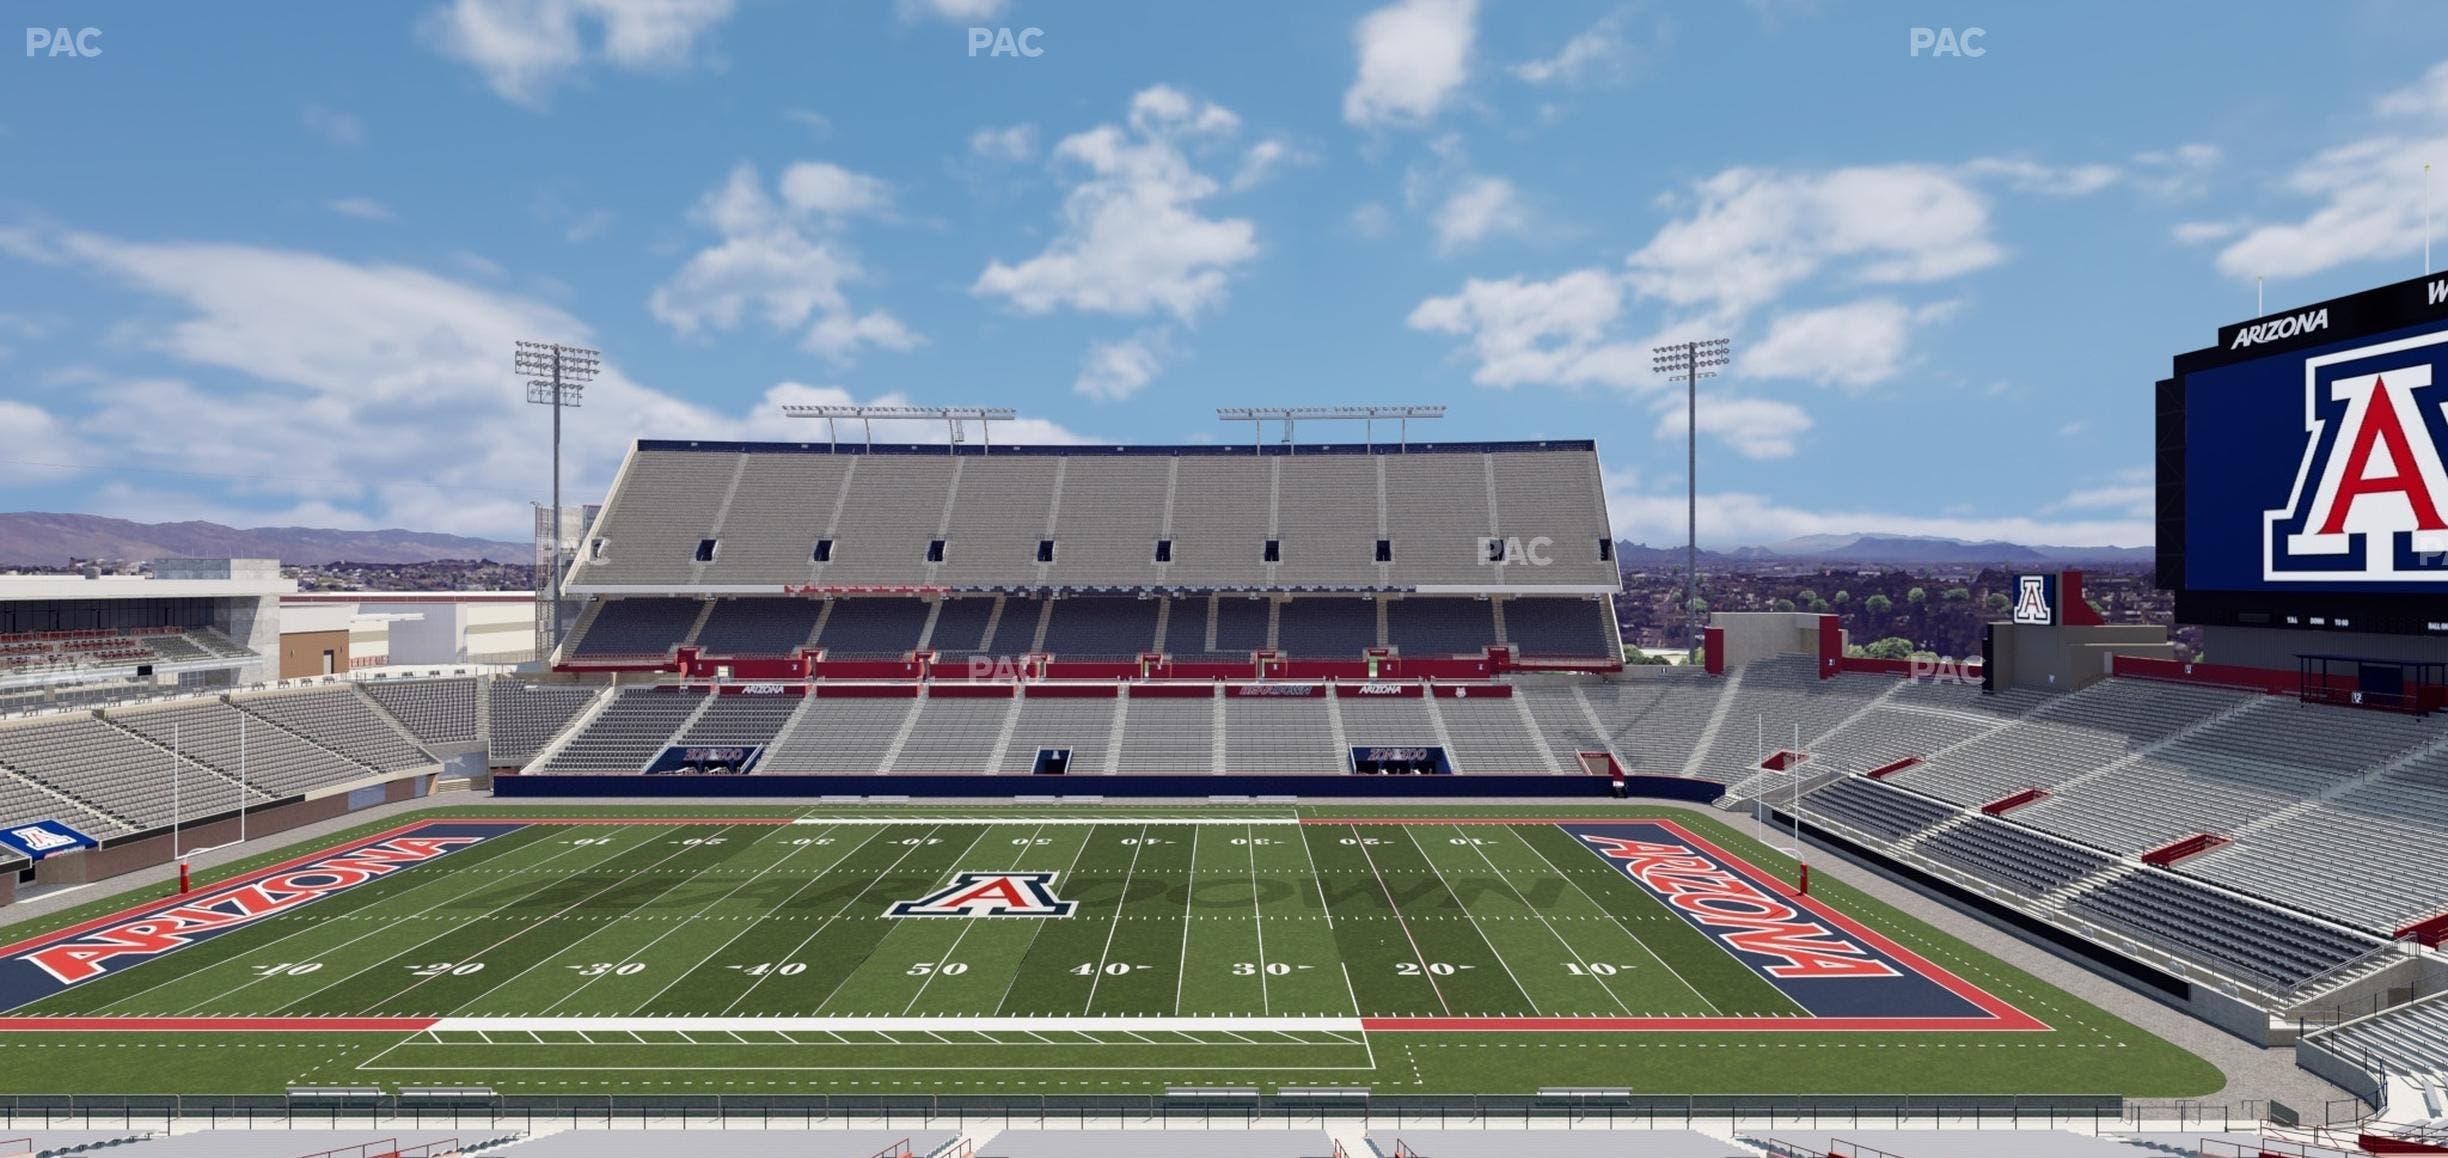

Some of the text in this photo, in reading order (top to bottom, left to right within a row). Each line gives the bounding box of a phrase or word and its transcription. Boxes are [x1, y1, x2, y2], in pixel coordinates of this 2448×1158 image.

[2231, 308, 2329, 350] ARIZONA
[2014, 575, 2051, 625] A
[741, 684, 784, 695] ARIZONA
[1359, 684, 1402, 695] ARIZONA
[14, 836, 486, 985] ARIZONA
[880, 871, 1079, 918] A
[1580, 834, 1904, 978] ARIZONA
[252, 962, 1617, 976] 10 20 30 40 50 40 30 20 10
